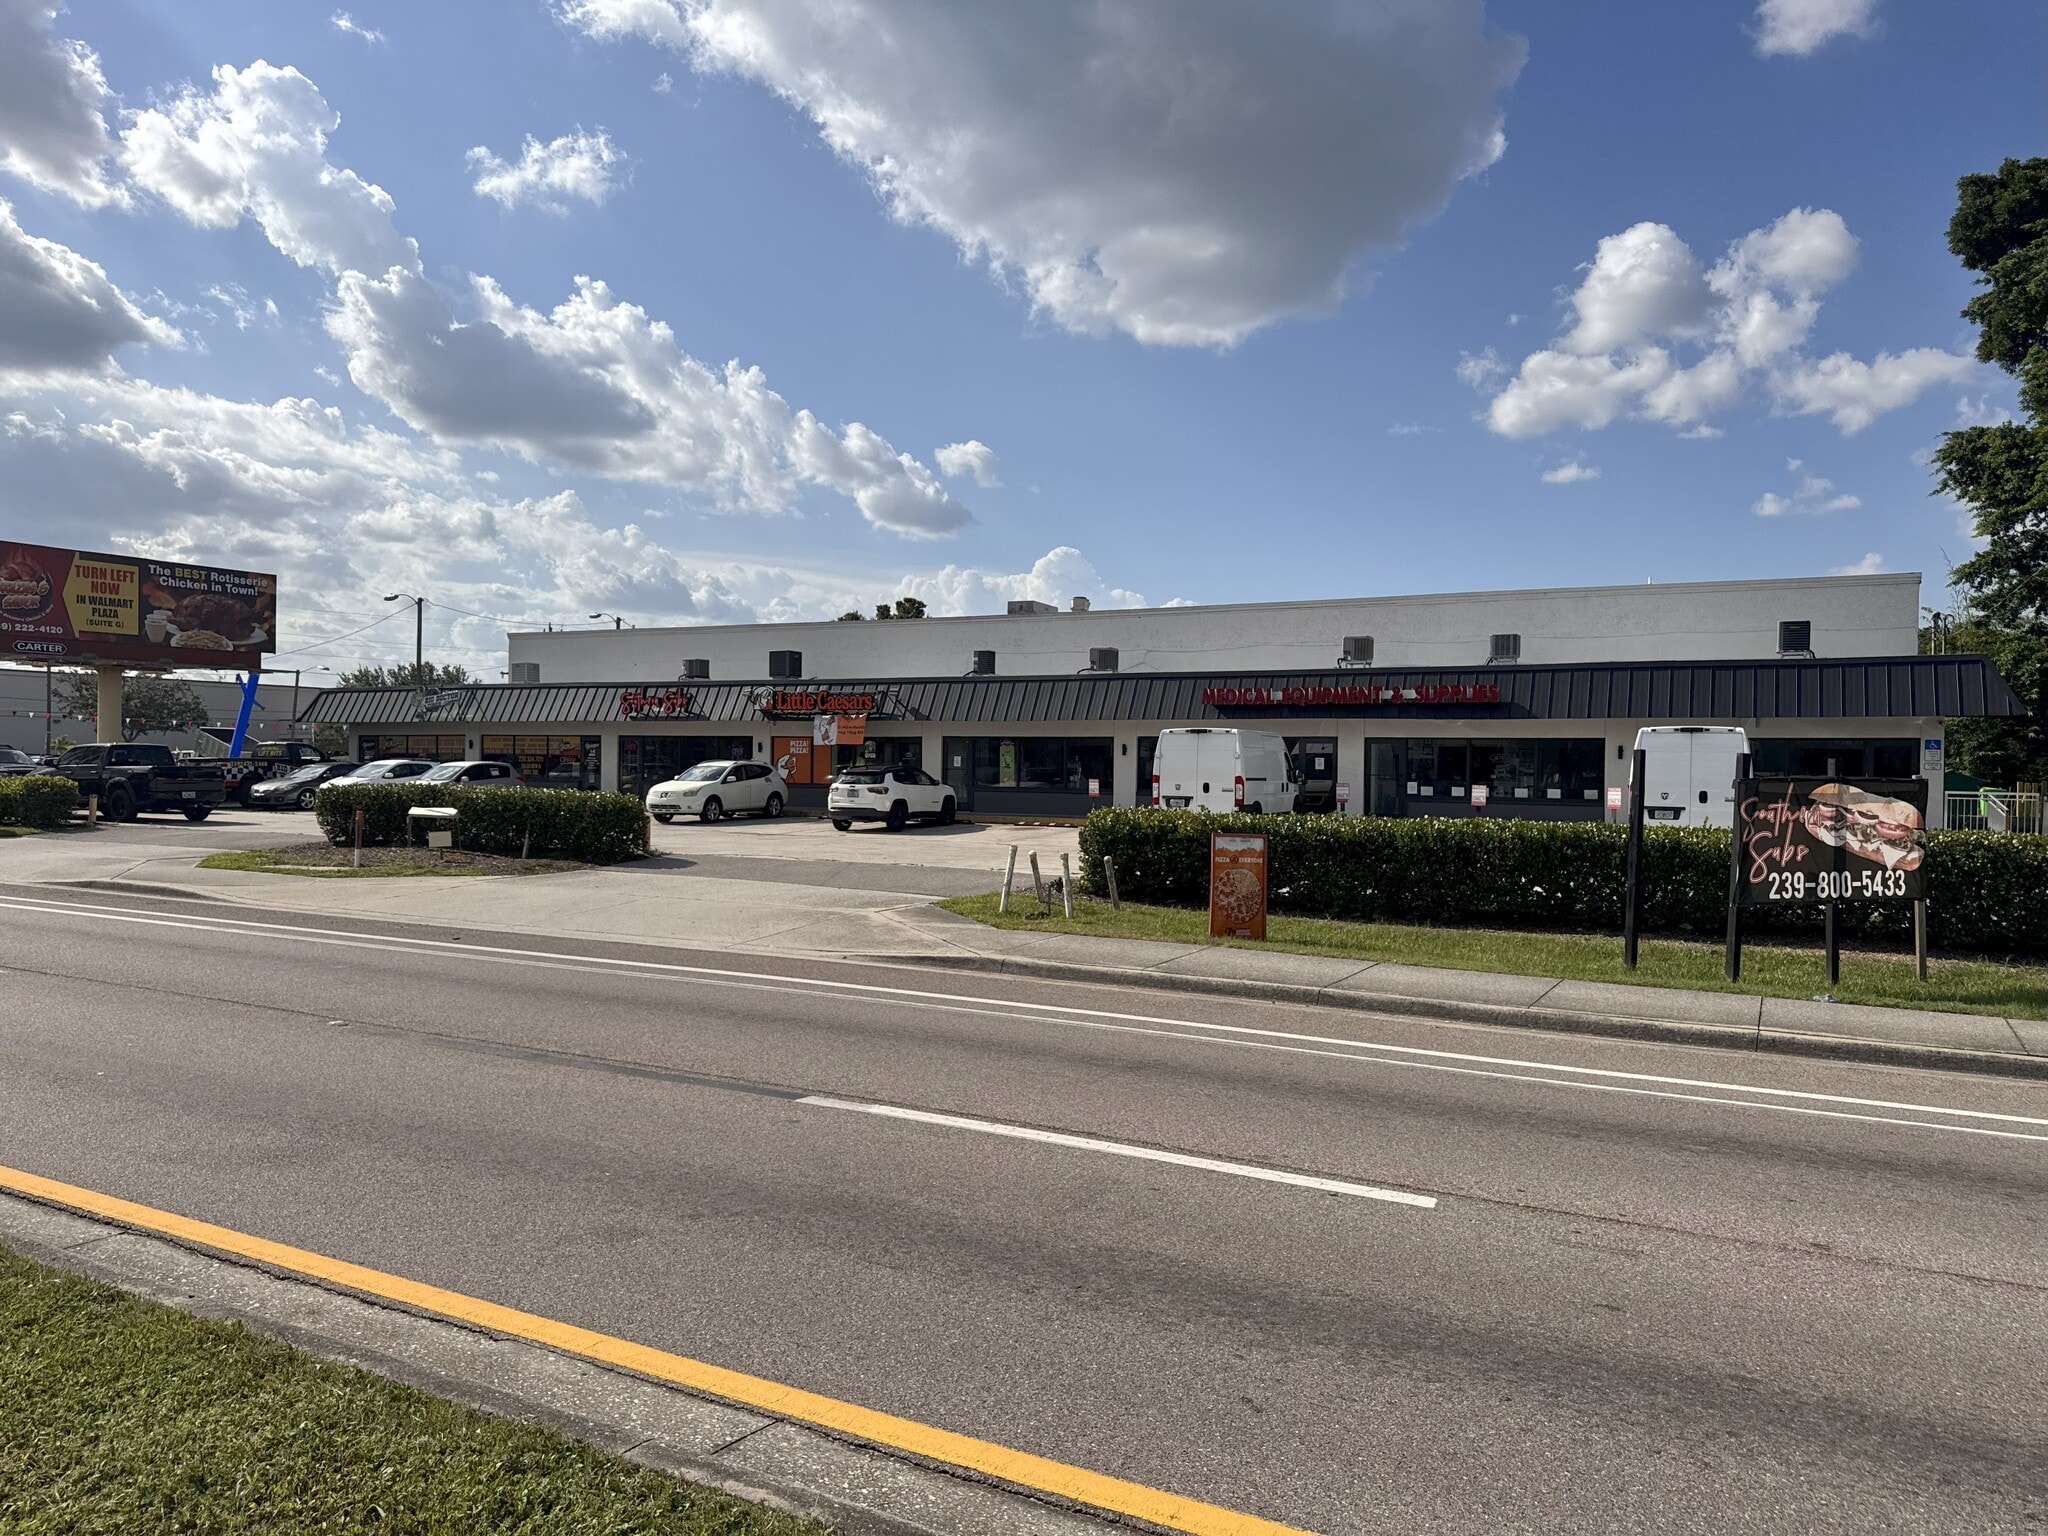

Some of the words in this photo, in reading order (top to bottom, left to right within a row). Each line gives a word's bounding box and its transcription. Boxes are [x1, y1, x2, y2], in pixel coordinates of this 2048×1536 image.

[74, 565, 107, 580] TURN
[111, 568, 136, 583] LEFT
[148, 564, 171, 576] The
[175, 567, 207, 580] BEST
[210, 572, 268, 587] Rotisserie
[91, 581, 120, 595] NOW
[160, 576, 208, 590] Chicken
[211, 582, 222, 592] in
[226, 584, 258, 596] Town!
[76, 594, 86, 604] IN
[88, 595, 134, 609] WALMART
[92, 607, 119, 618] PLAZA
[0, 622, 12, 631] 9)
[15, 623, 63, 634] 222-4120
[86, 619, 113, 627] (SUITE
[17, 643, 63, 652] CARTER
[436, 691, 459, 701] DOCTOR
[776, 690, 814, 710] Little
[817, 690, 874, 710] Caesars
[1202, 687, 1276, 705] MEDICAL
[1281, 686, 1383, 706] EQUIPMENT
[1391, 686, 1404, 704] &
[1415, 684, 1499, 703] SUPPLIES
[1740, 783, 1825, 842] Southern
[1749, 822, 1809, 884] Subs
[1768, 870, 1906, 900] 239-800-5433
